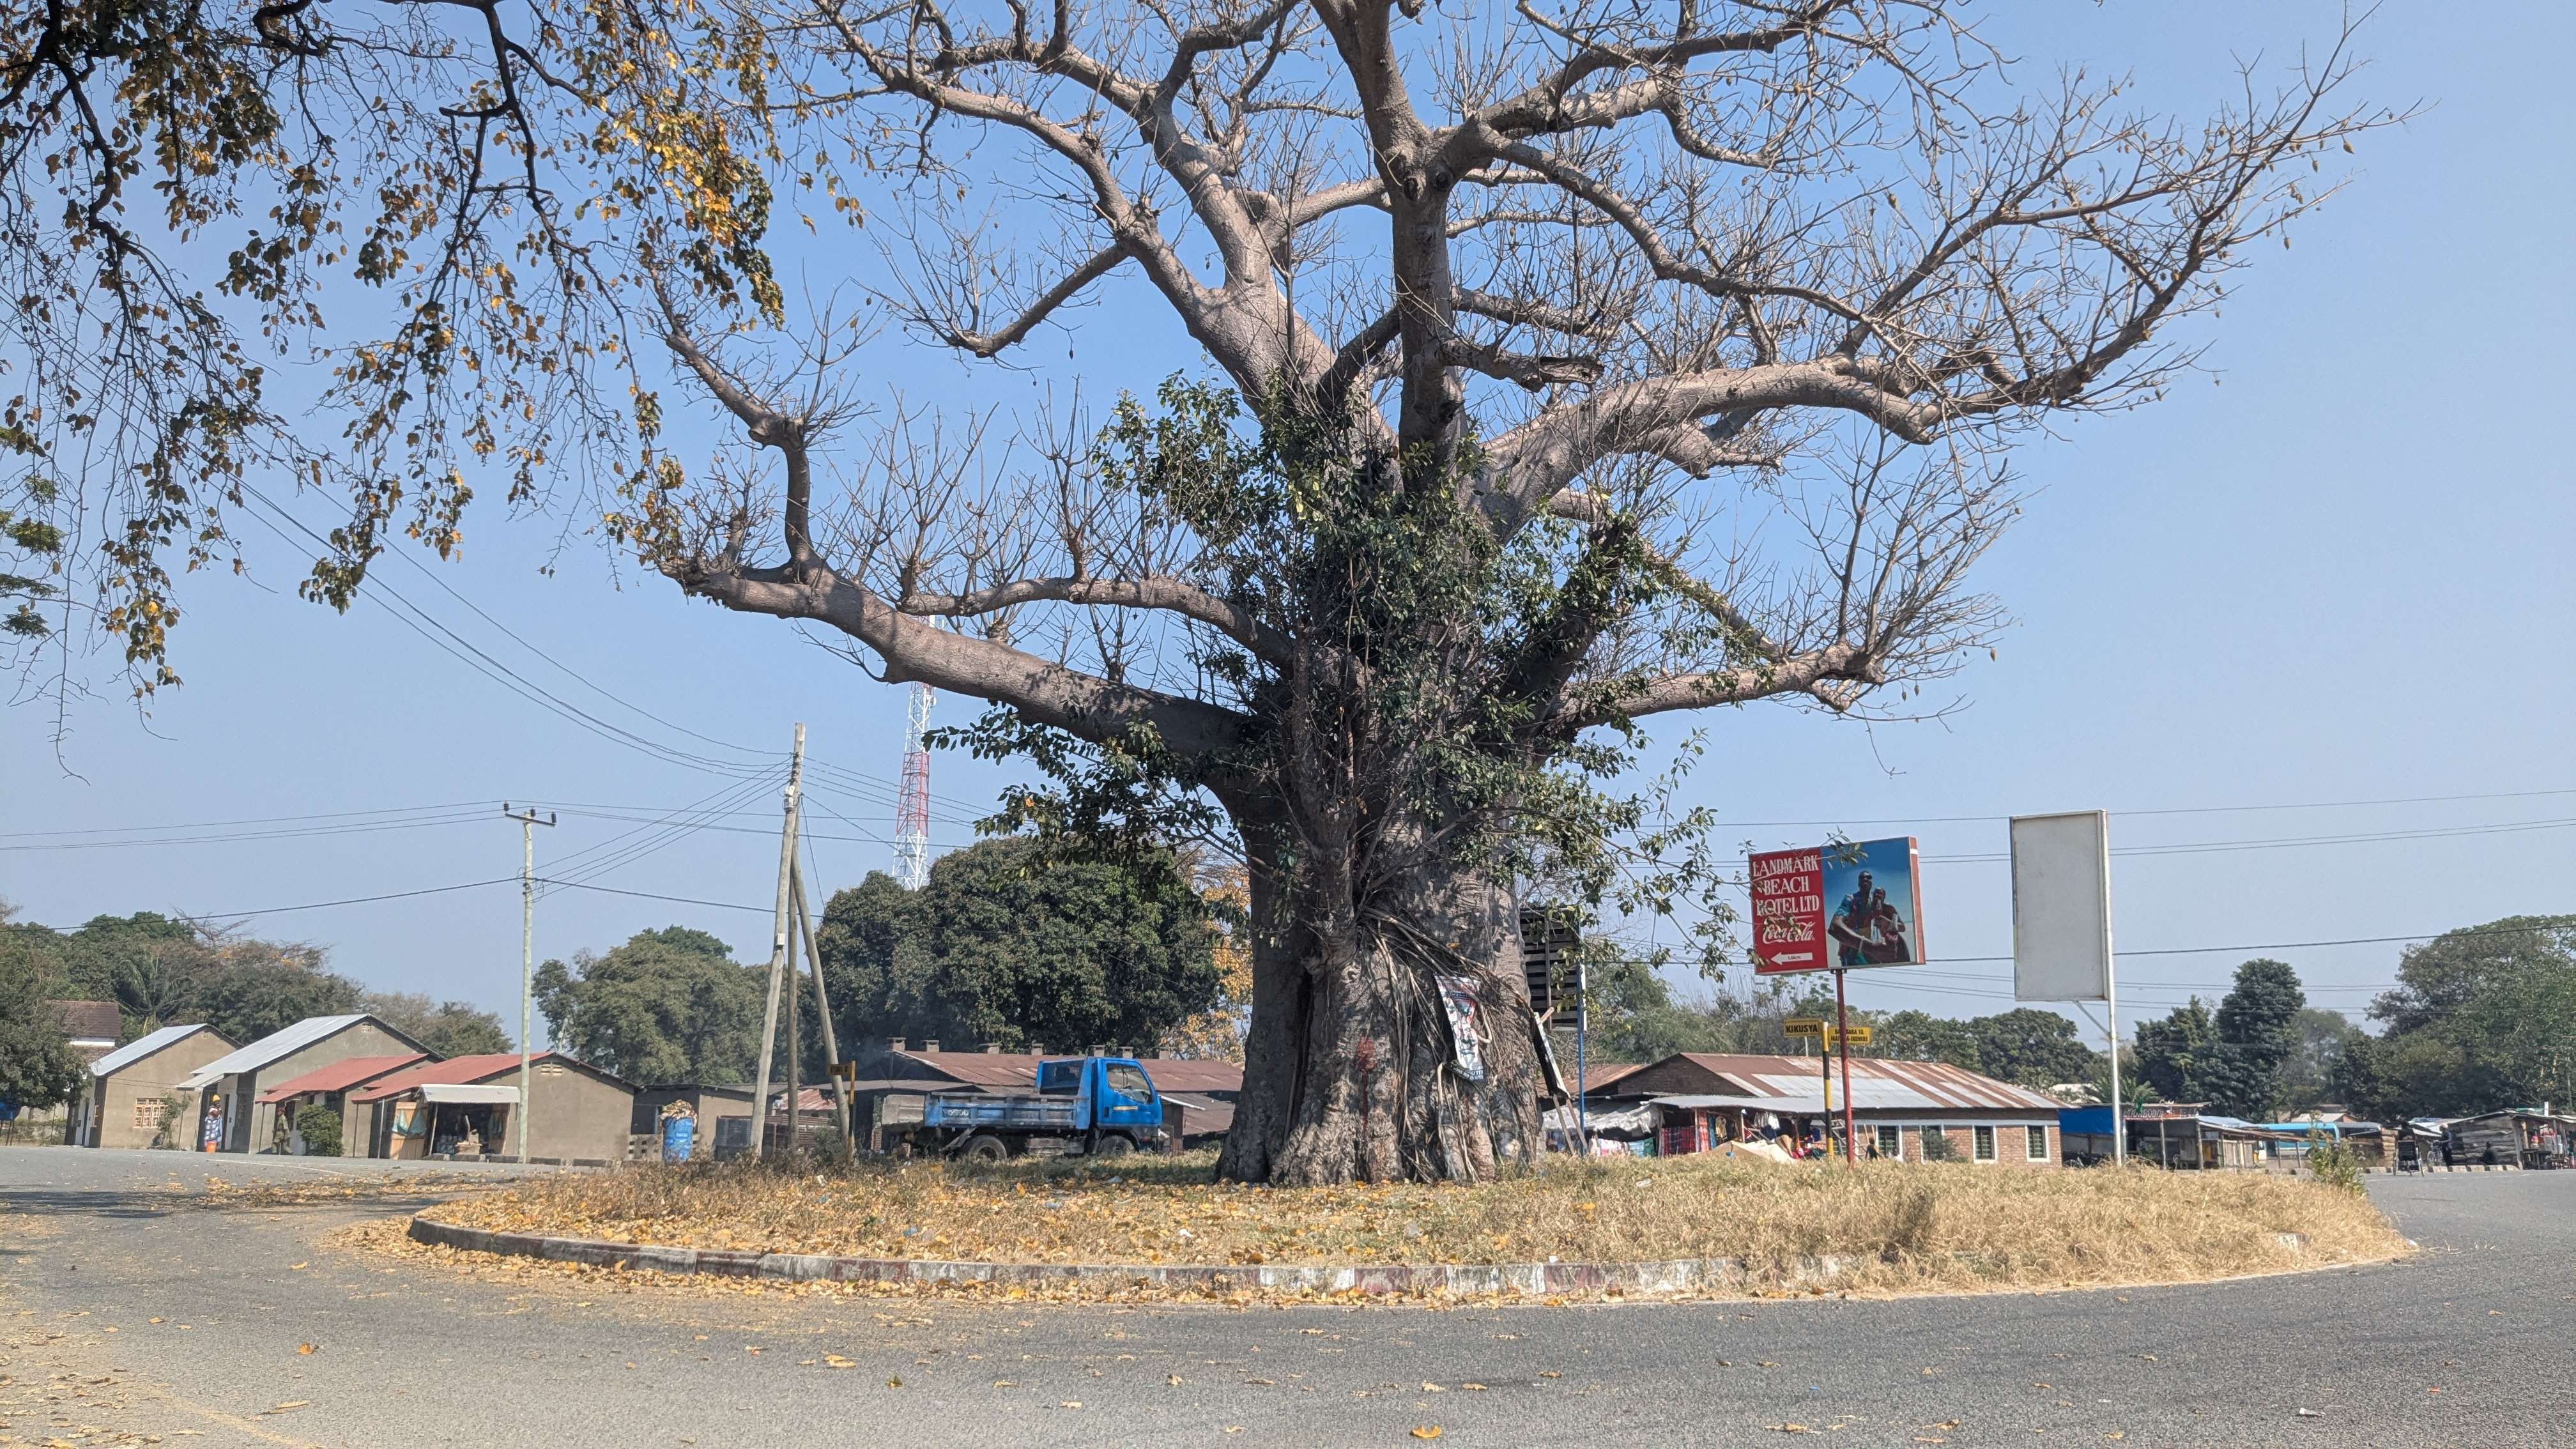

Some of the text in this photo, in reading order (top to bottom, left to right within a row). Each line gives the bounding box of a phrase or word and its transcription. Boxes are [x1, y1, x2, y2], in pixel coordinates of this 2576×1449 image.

[1752, 855, 1820, 877] LANDMARK
[1763, 876, 1810, 896] BEACH
[1756, 895, 1820, 916] HOTEL LTD
[1786, 1024, 1818, 1033] KIKUSYA
